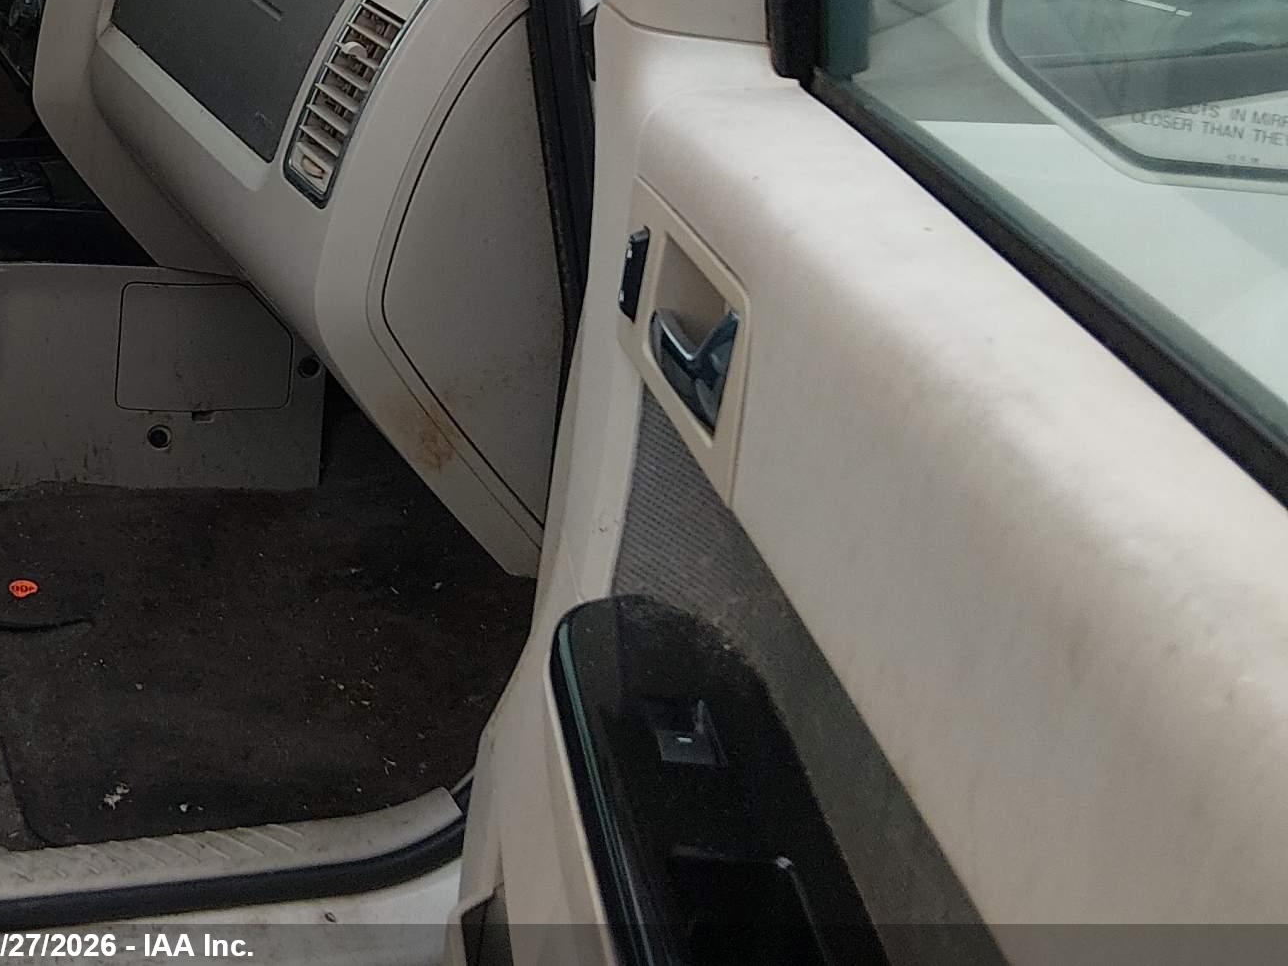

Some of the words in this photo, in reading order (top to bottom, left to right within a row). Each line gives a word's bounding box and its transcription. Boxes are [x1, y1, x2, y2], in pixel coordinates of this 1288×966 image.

[1131, 112, 1194, 132] CLOSER
[1202, 120, 1245, 140] THAN
[1231, 108, 1247, 123] IN
